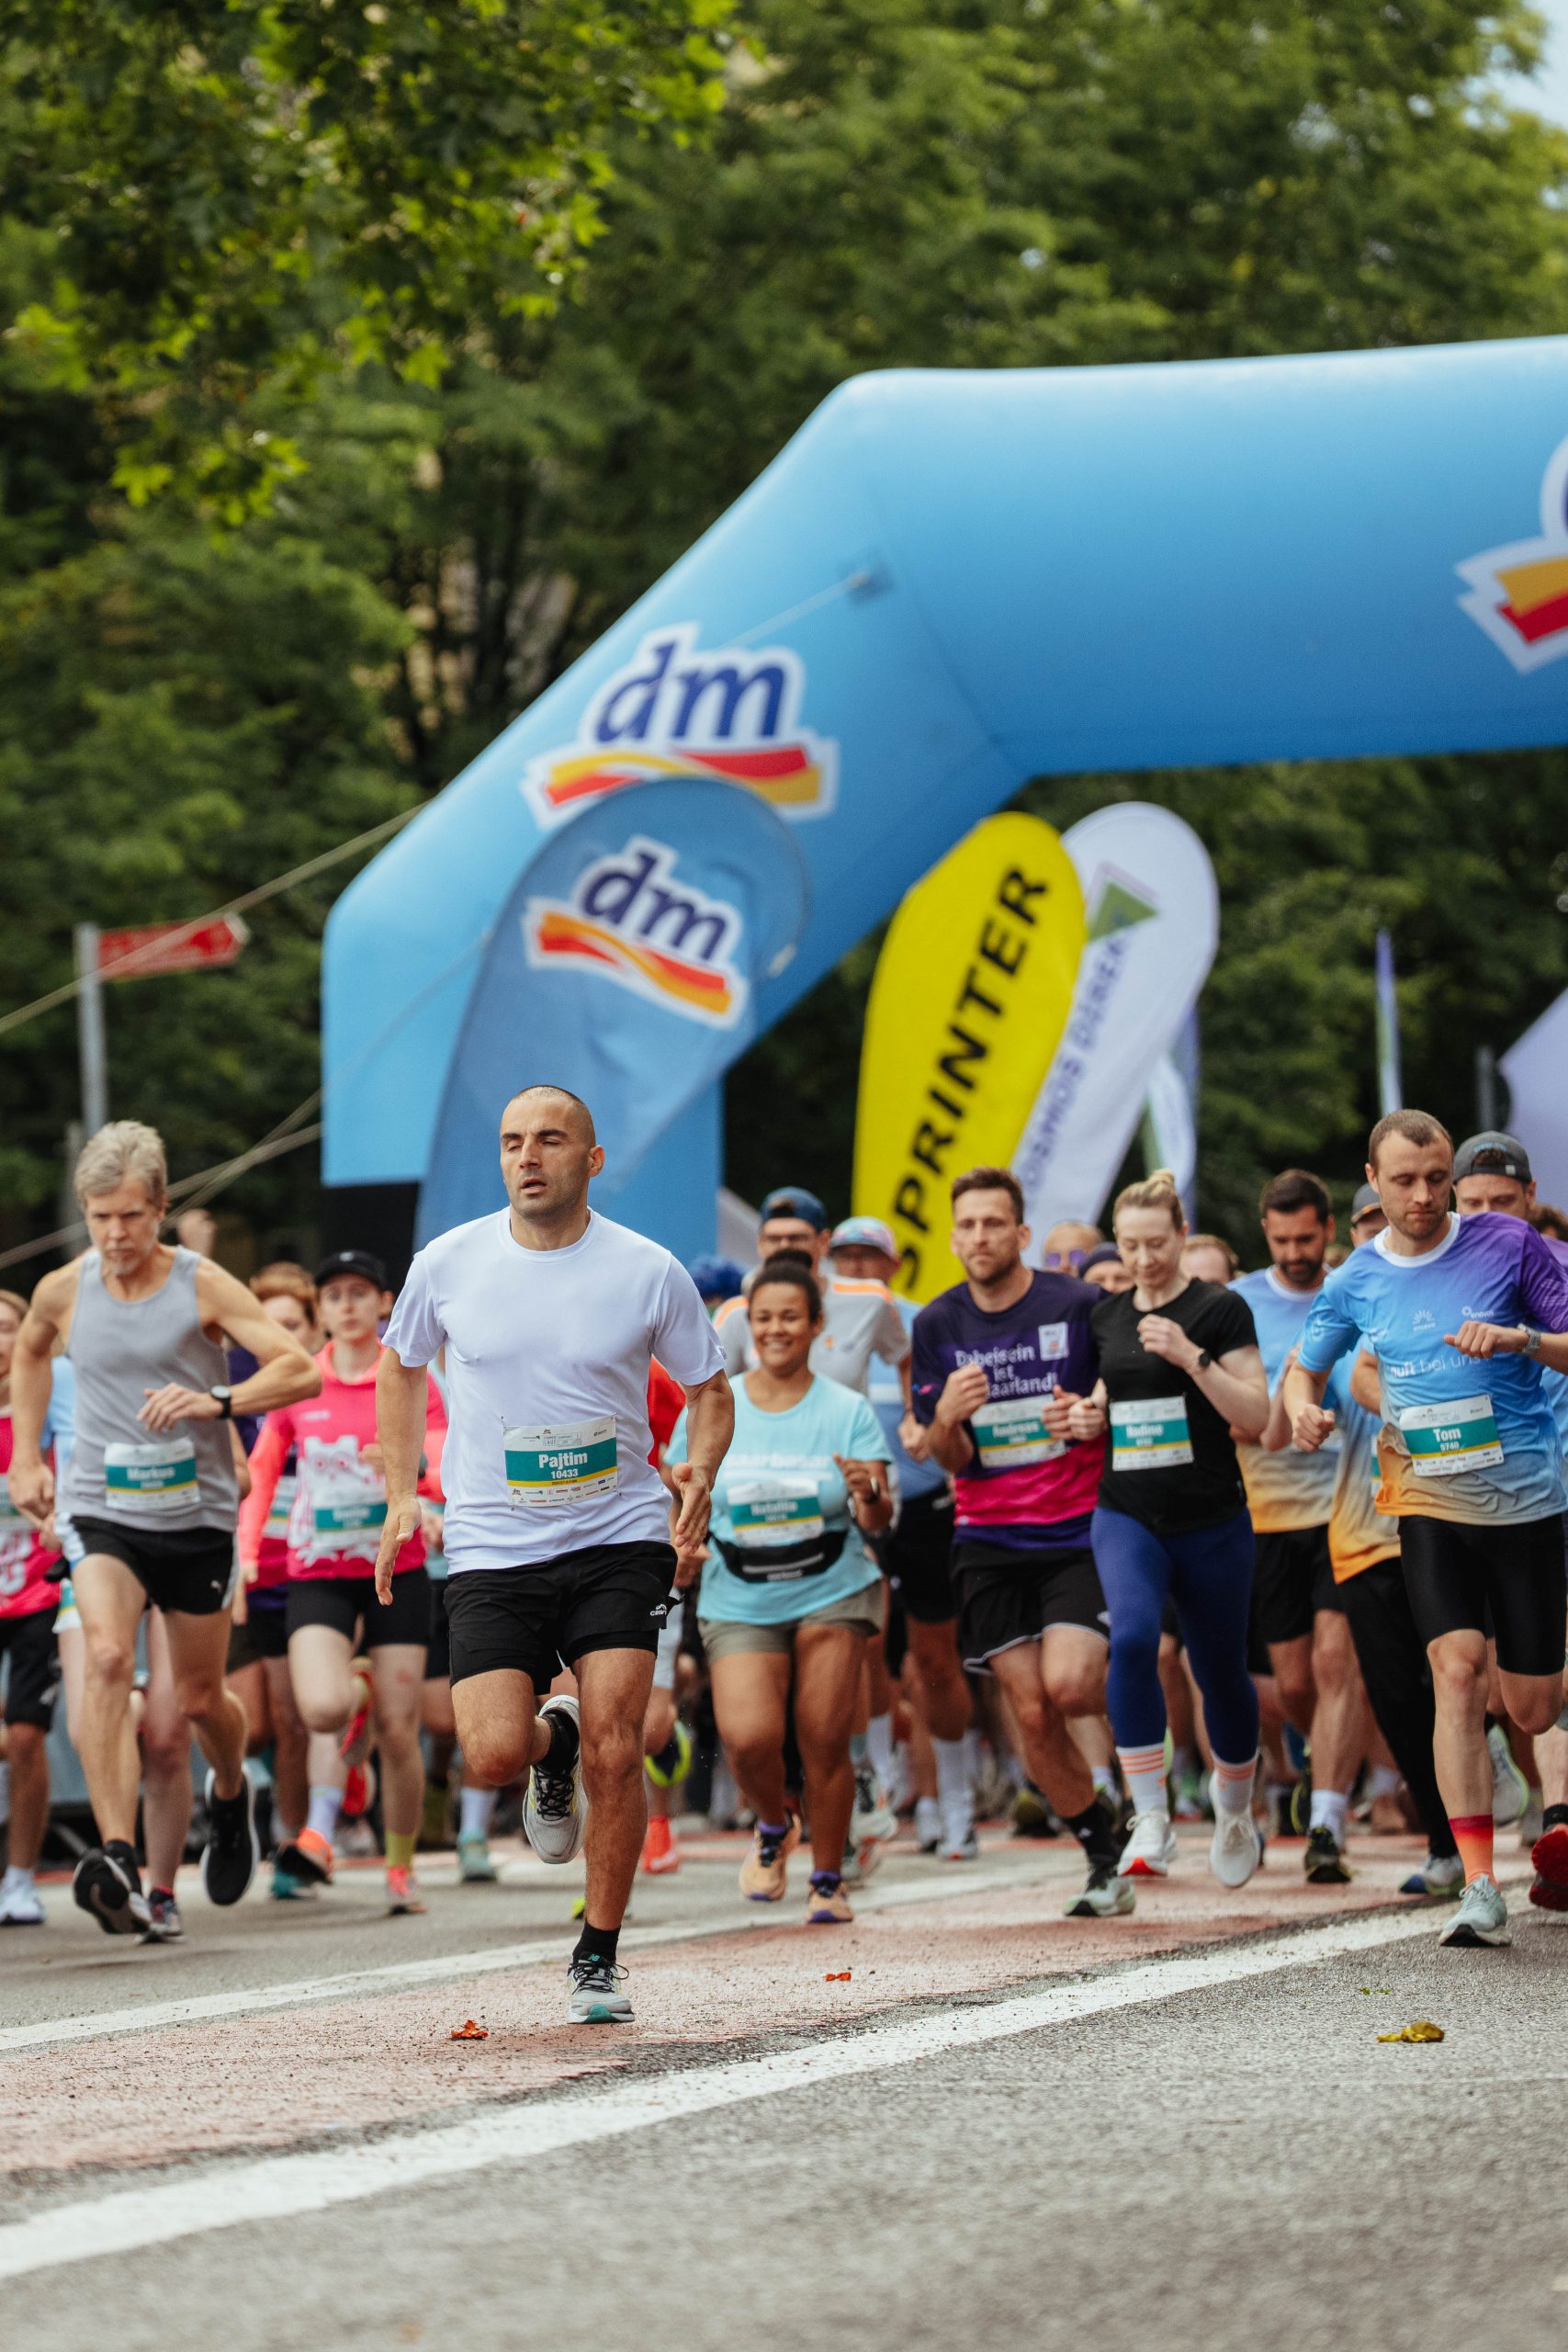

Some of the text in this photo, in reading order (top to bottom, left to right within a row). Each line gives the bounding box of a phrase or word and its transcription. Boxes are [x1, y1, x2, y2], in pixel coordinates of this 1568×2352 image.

[594, 641, 788, 743] dm
[579, 846, 728, 962] dm
[954, 1343, 1035, 1368] Dabeisein
[993, 1363, 1014, 1383] ist
[1419, 1358, 1446, 1374] bei
[1433, 1428, 1461, 1442] Tom
[538, 1453, 588, 1470] Pajtim
[550, 1468, 579, 1479] 10433
[588, 1953, 600, 1962] NB
